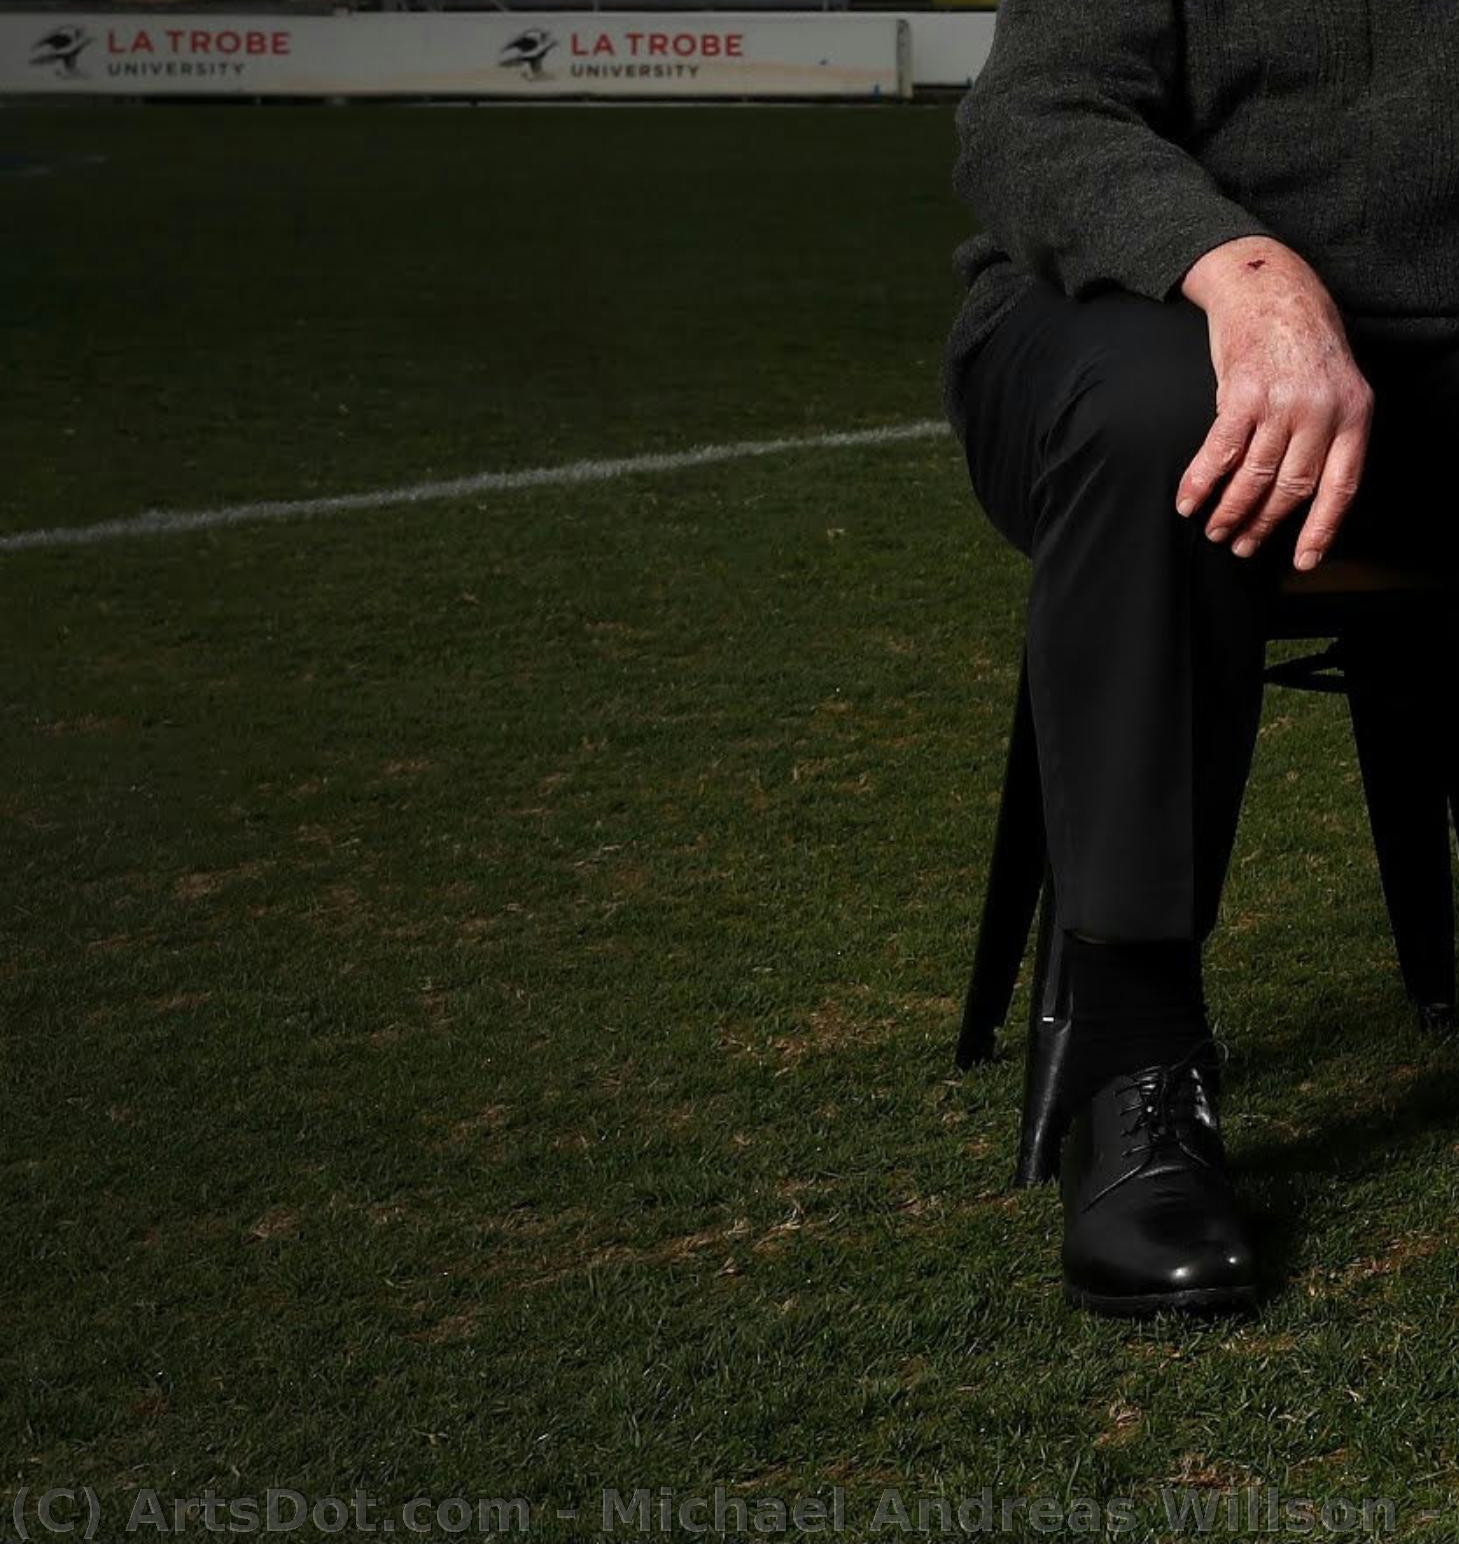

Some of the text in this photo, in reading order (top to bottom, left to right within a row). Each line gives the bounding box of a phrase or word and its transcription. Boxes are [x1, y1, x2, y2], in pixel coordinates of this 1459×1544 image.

[107, 29, 291, 55] LA TROBE
[570, 33, 744, 57] LA TROBE
[106, 61, 245, 77] UNIVERSITY
[570, 64, 700, 78] UNIVERSITY
